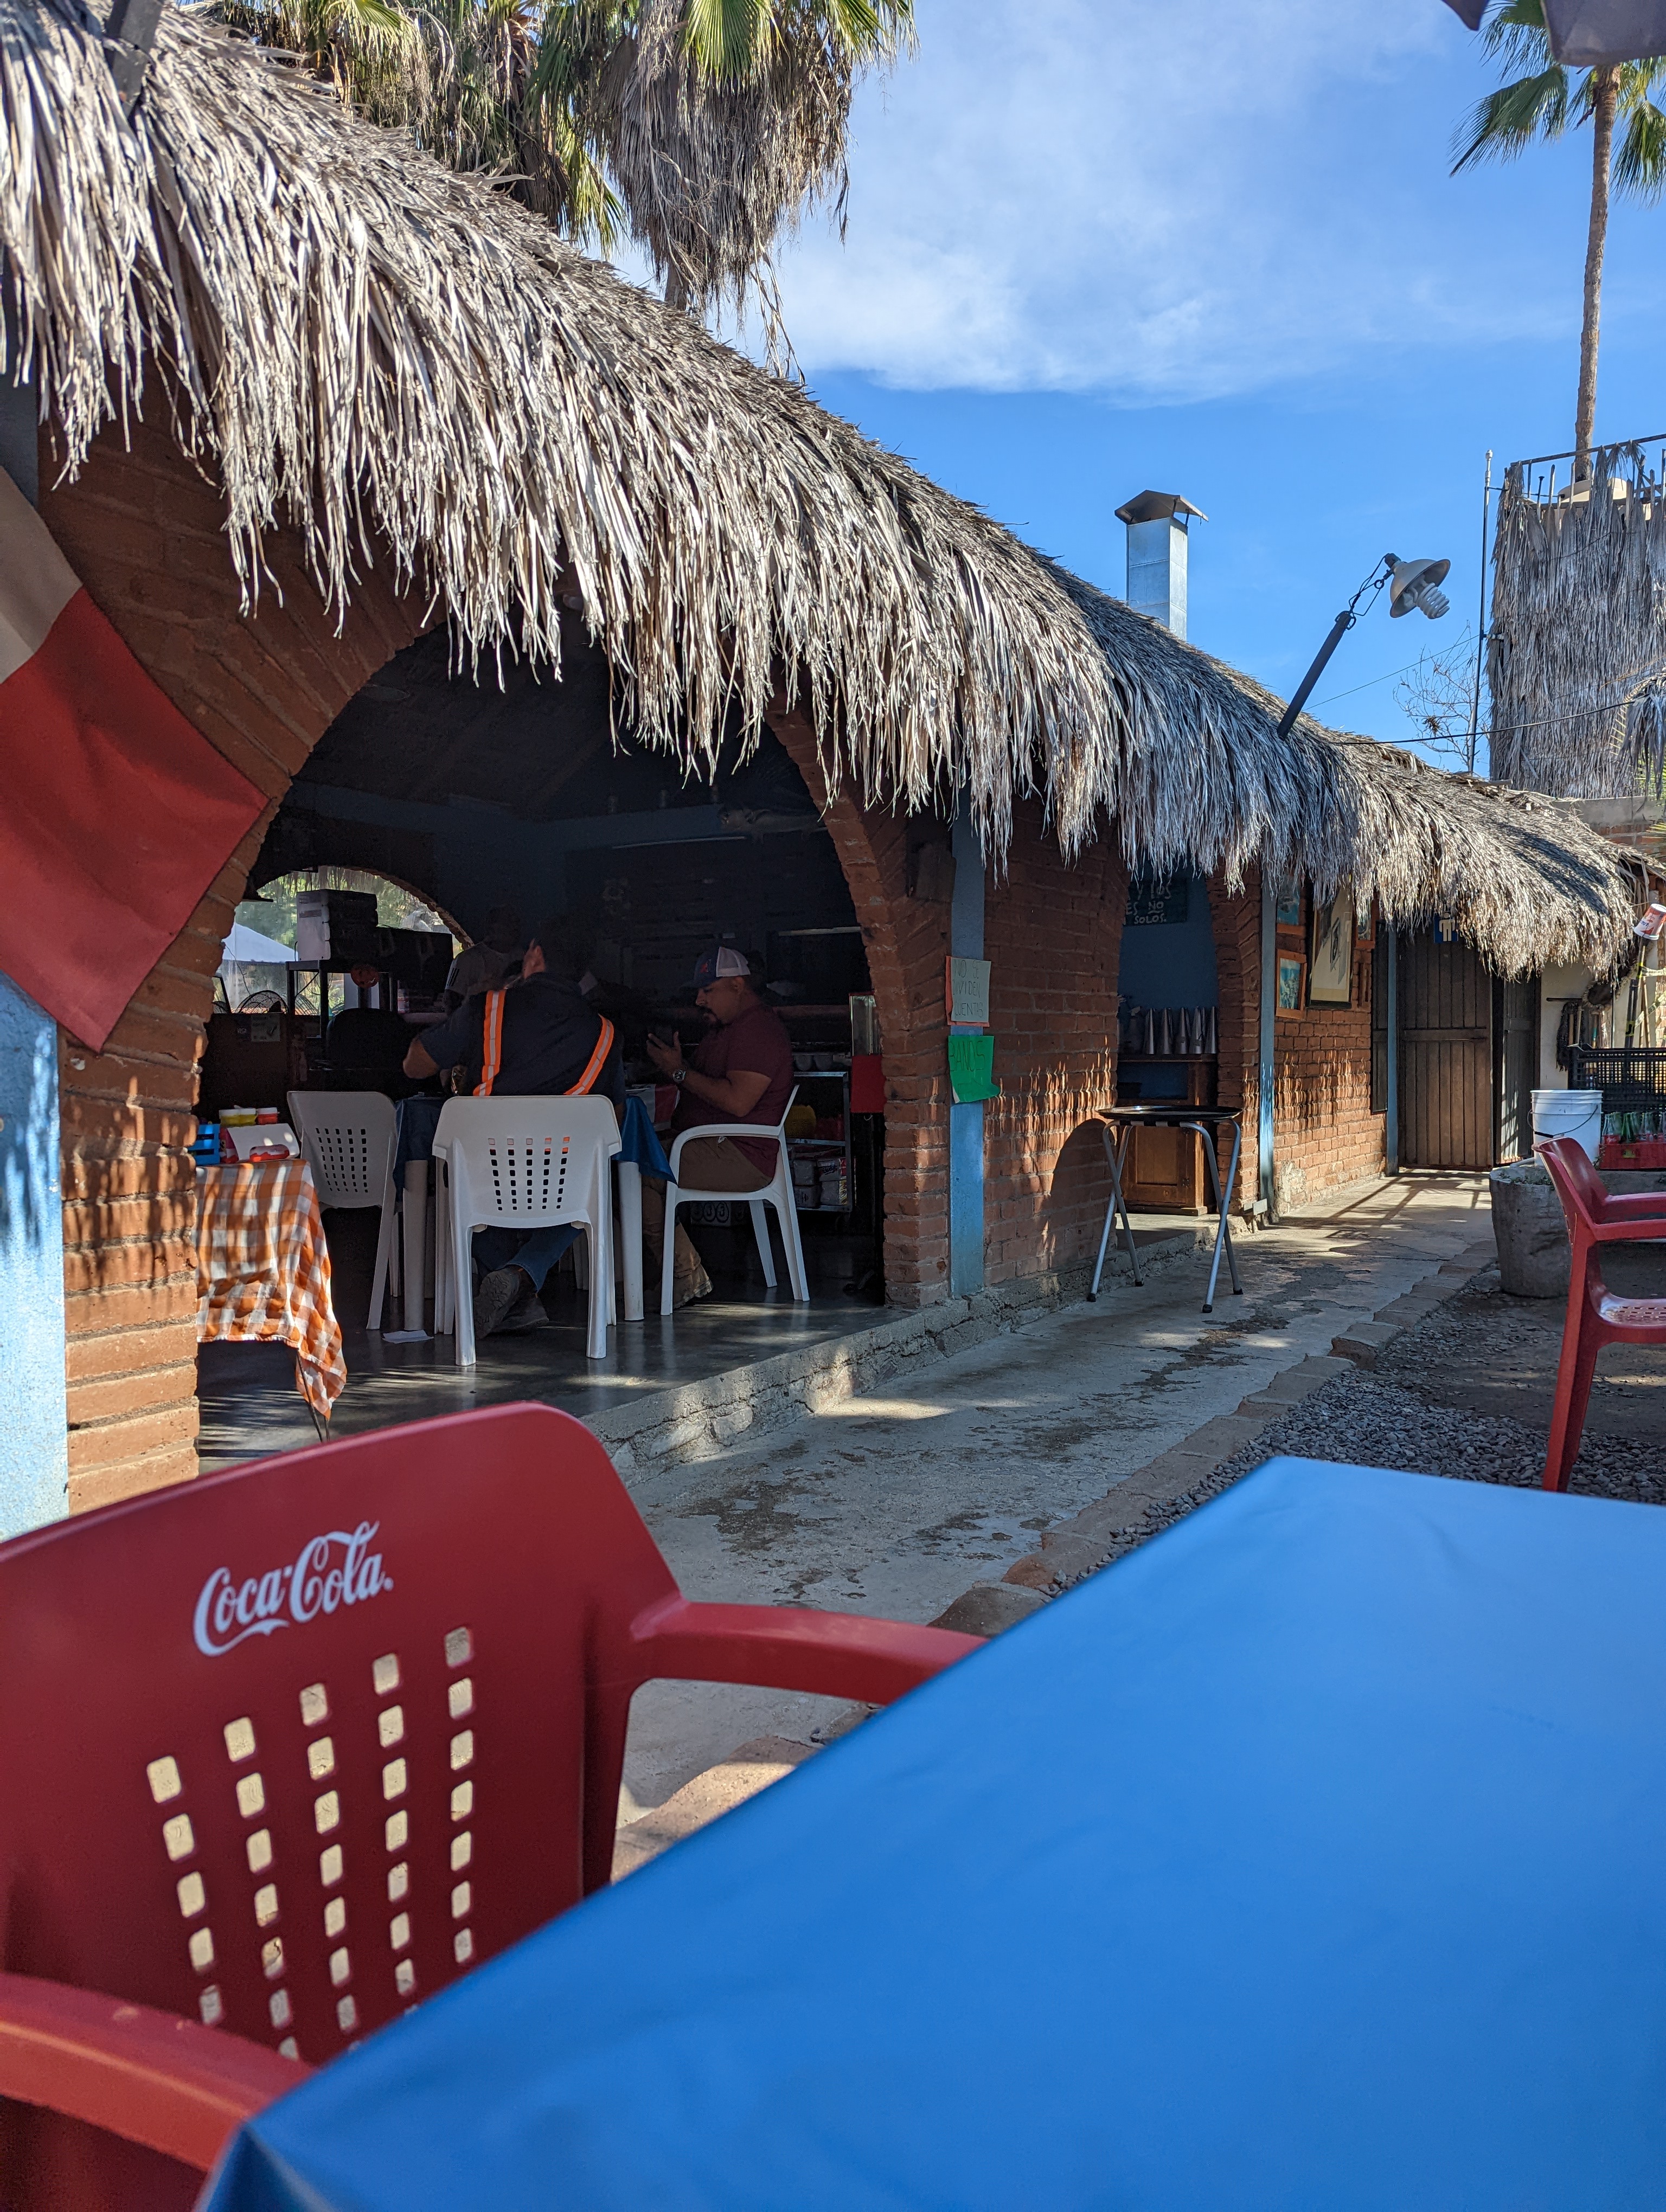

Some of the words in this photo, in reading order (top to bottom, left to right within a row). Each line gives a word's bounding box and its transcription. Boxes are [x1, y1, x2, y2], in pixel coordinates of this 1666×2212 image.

[1151, 883, 1171, 899] LOS
[1148, 901, 1164, 910] NO
[954, 960, 967, 978] NO
[973, 960, 982, 979] SE
[952, 979, 981, 998] DIVIDEN
[954, 1002, 983, 1018] CUENTAS
